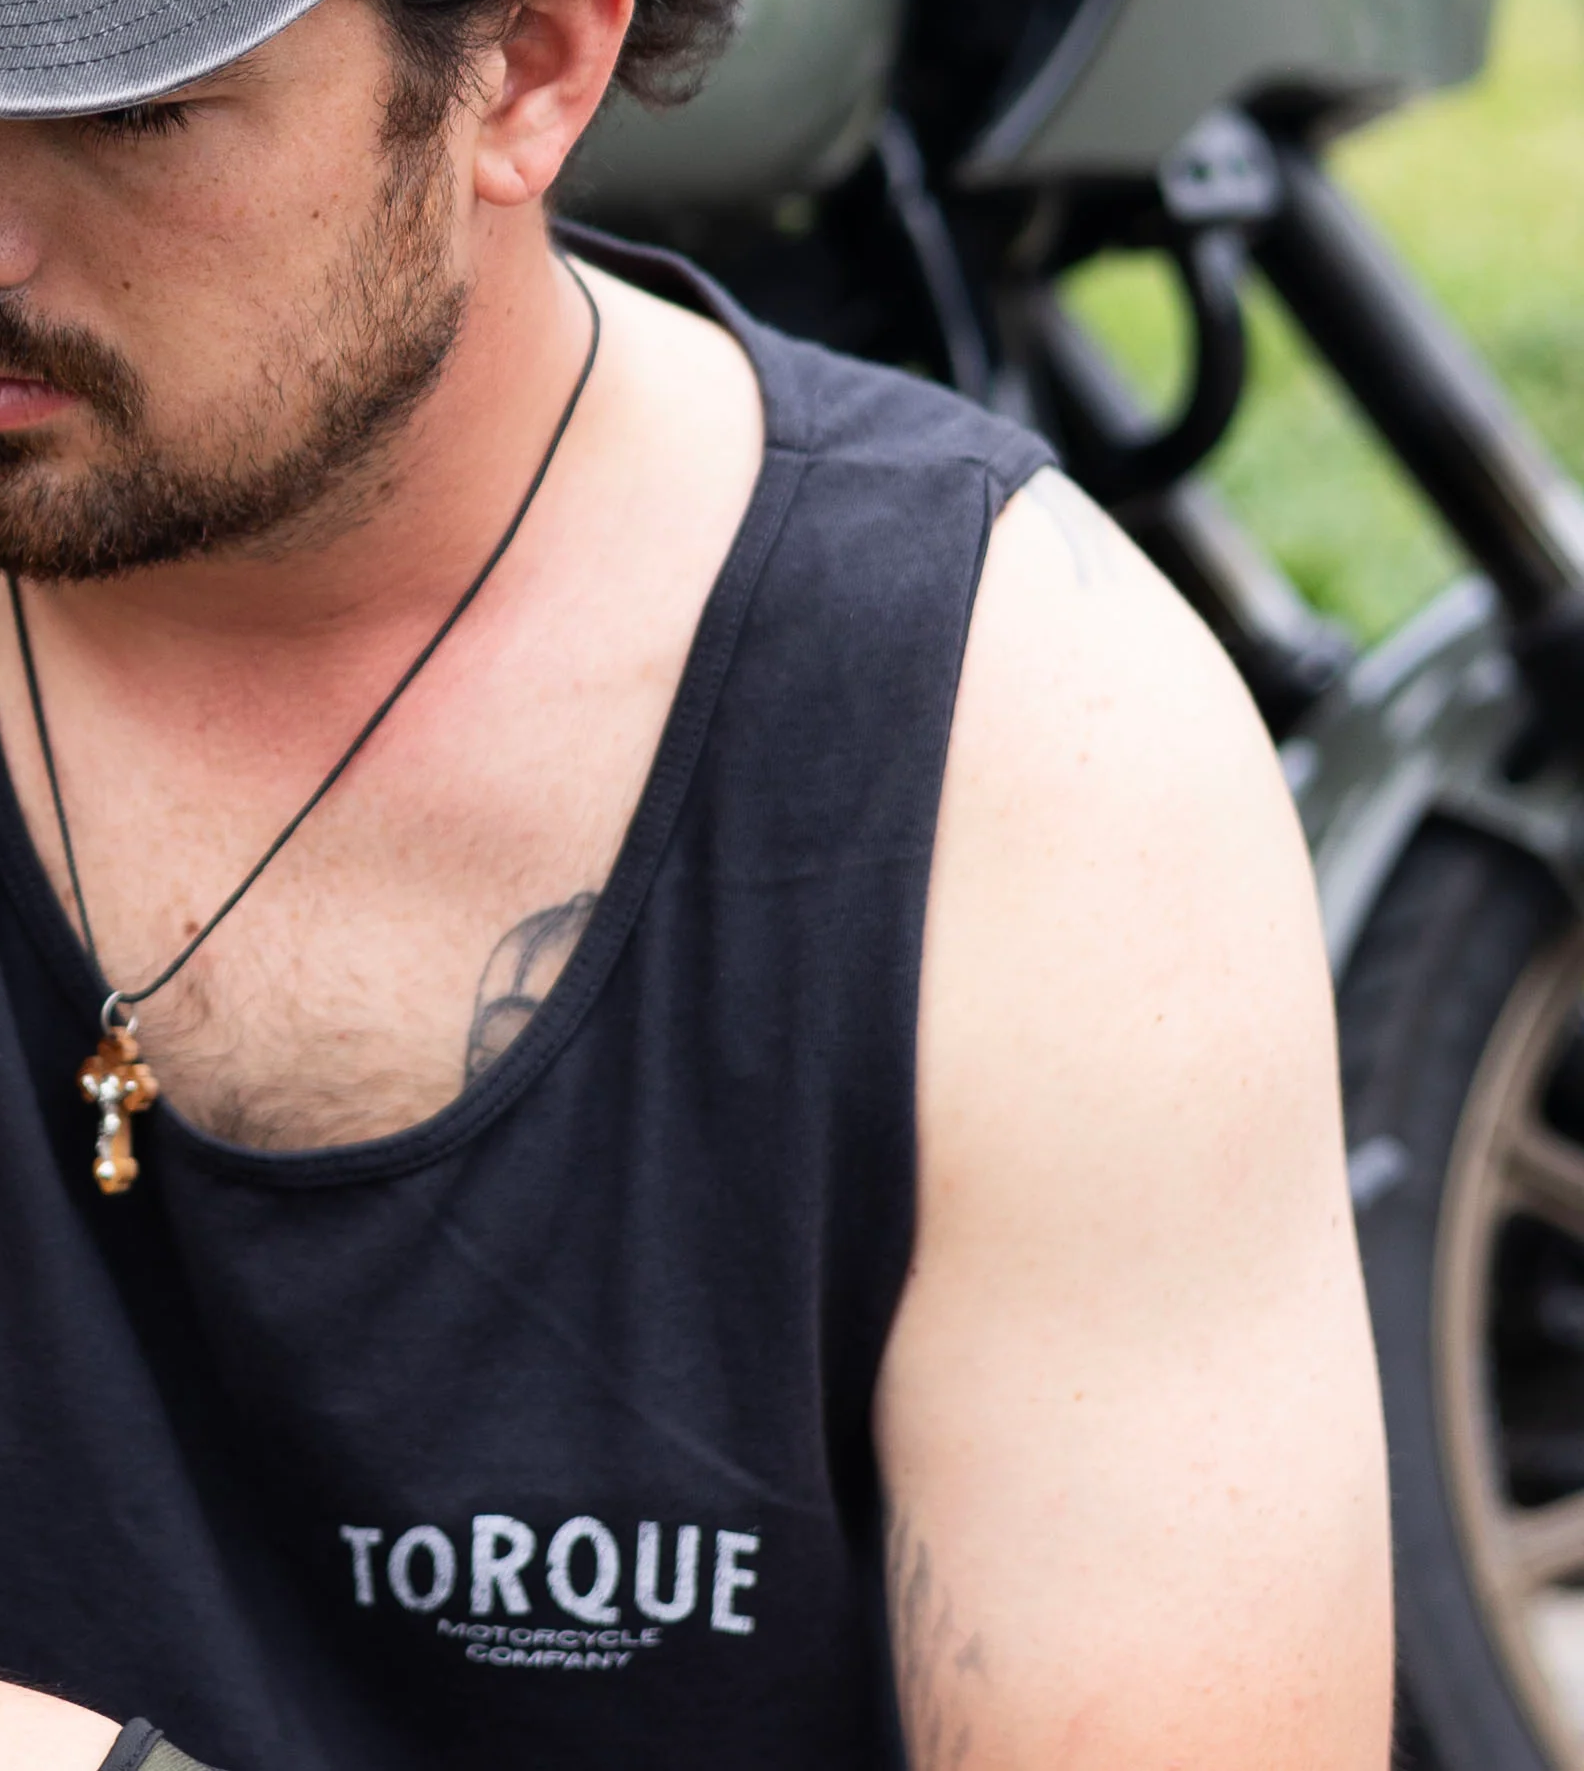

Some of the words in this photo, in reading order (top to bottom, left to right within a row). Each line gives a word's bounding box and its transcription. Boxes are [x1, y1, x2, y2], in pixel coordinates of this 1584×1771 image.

[340, 1514, 760, 1634] TORQUE
[437, 1618, 664, 1647] MOTORCYCLE
[465, 1643, 634, 1670] COMPANY
